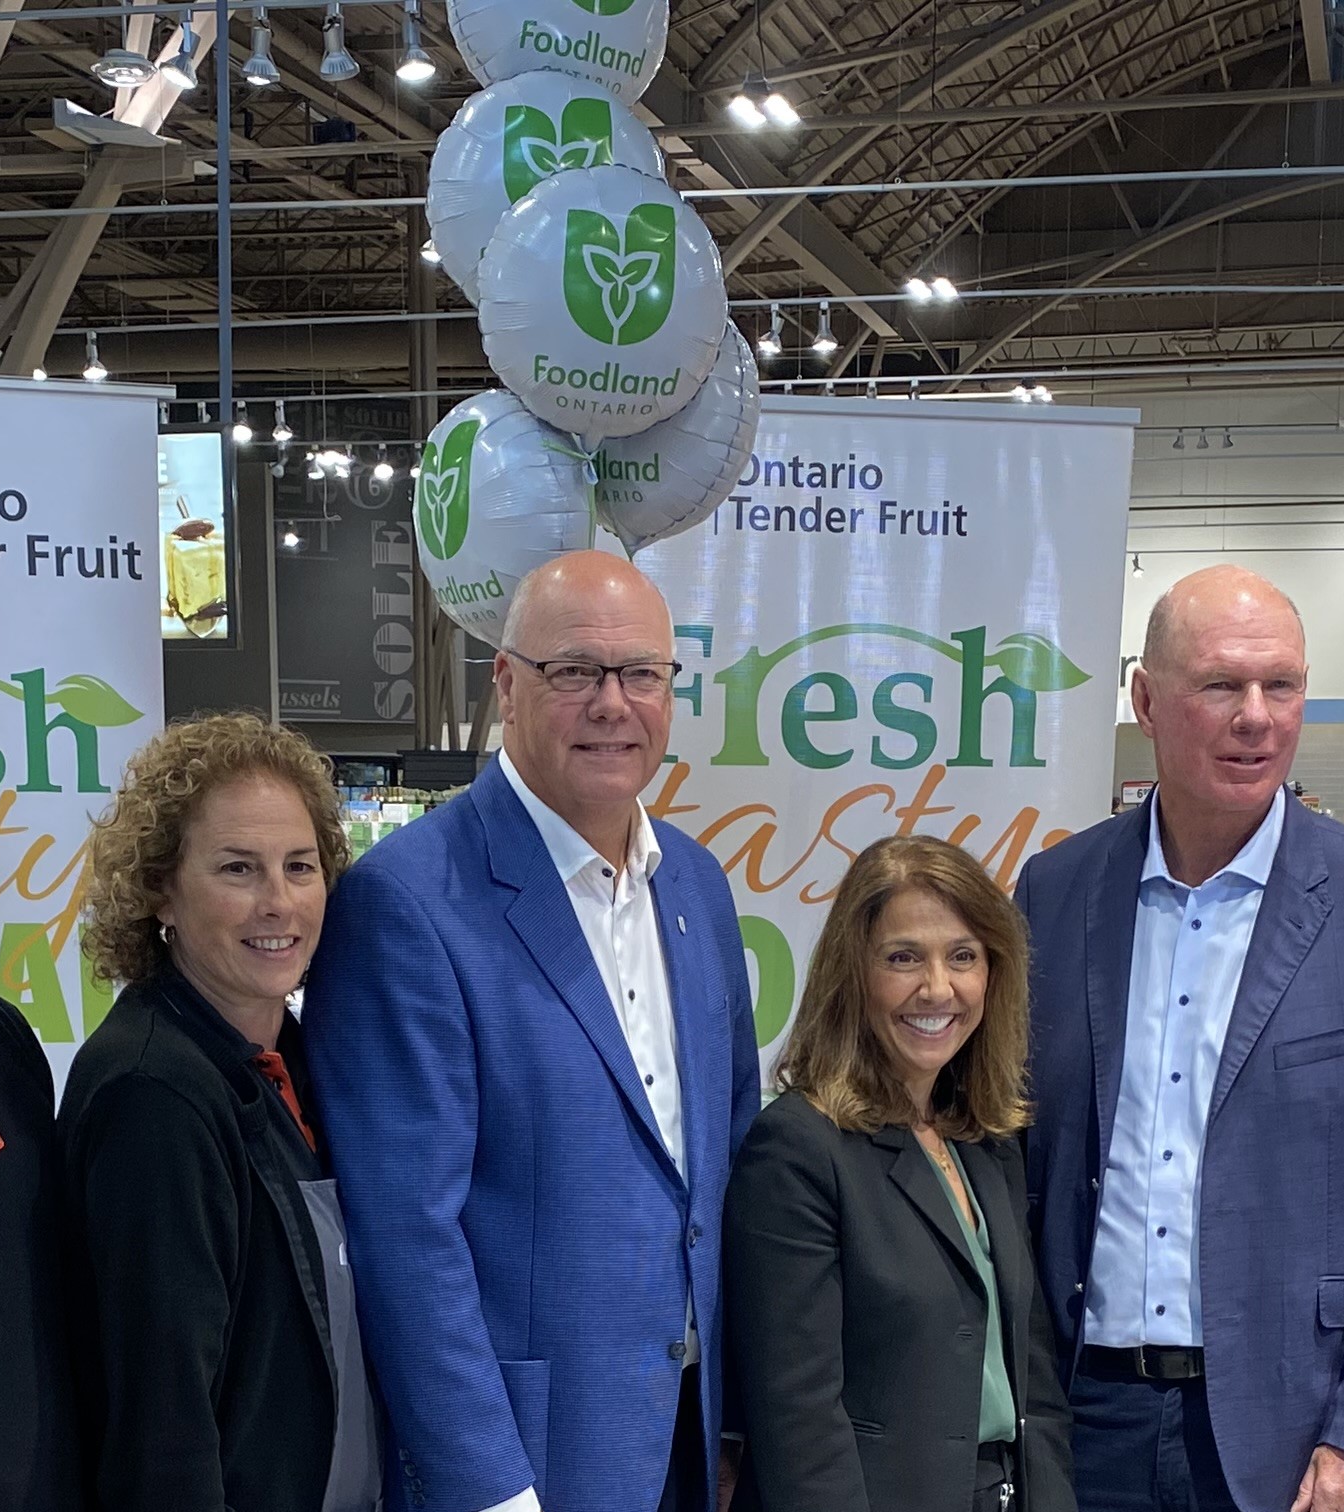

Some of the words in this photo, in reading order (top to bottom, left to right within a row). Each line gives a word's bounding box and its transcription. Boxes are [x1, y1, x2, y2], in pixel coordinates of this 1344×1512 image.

[520, 20, 646, 78] Foodland
[534, 354, 681, 396] Foodland
[556, 395, 653, 415] ONTARIO
[592, 449, 660, 482] dland
[737, 453, 883, 491] Ontario
[601, 490, 643, 502] ARIO
[729, 497, 865, 534] Tender
[879, 500, 969, 537] Fruit
[27, 534, 143, 580] Fruit
[434, 570, 504, 605] odland
